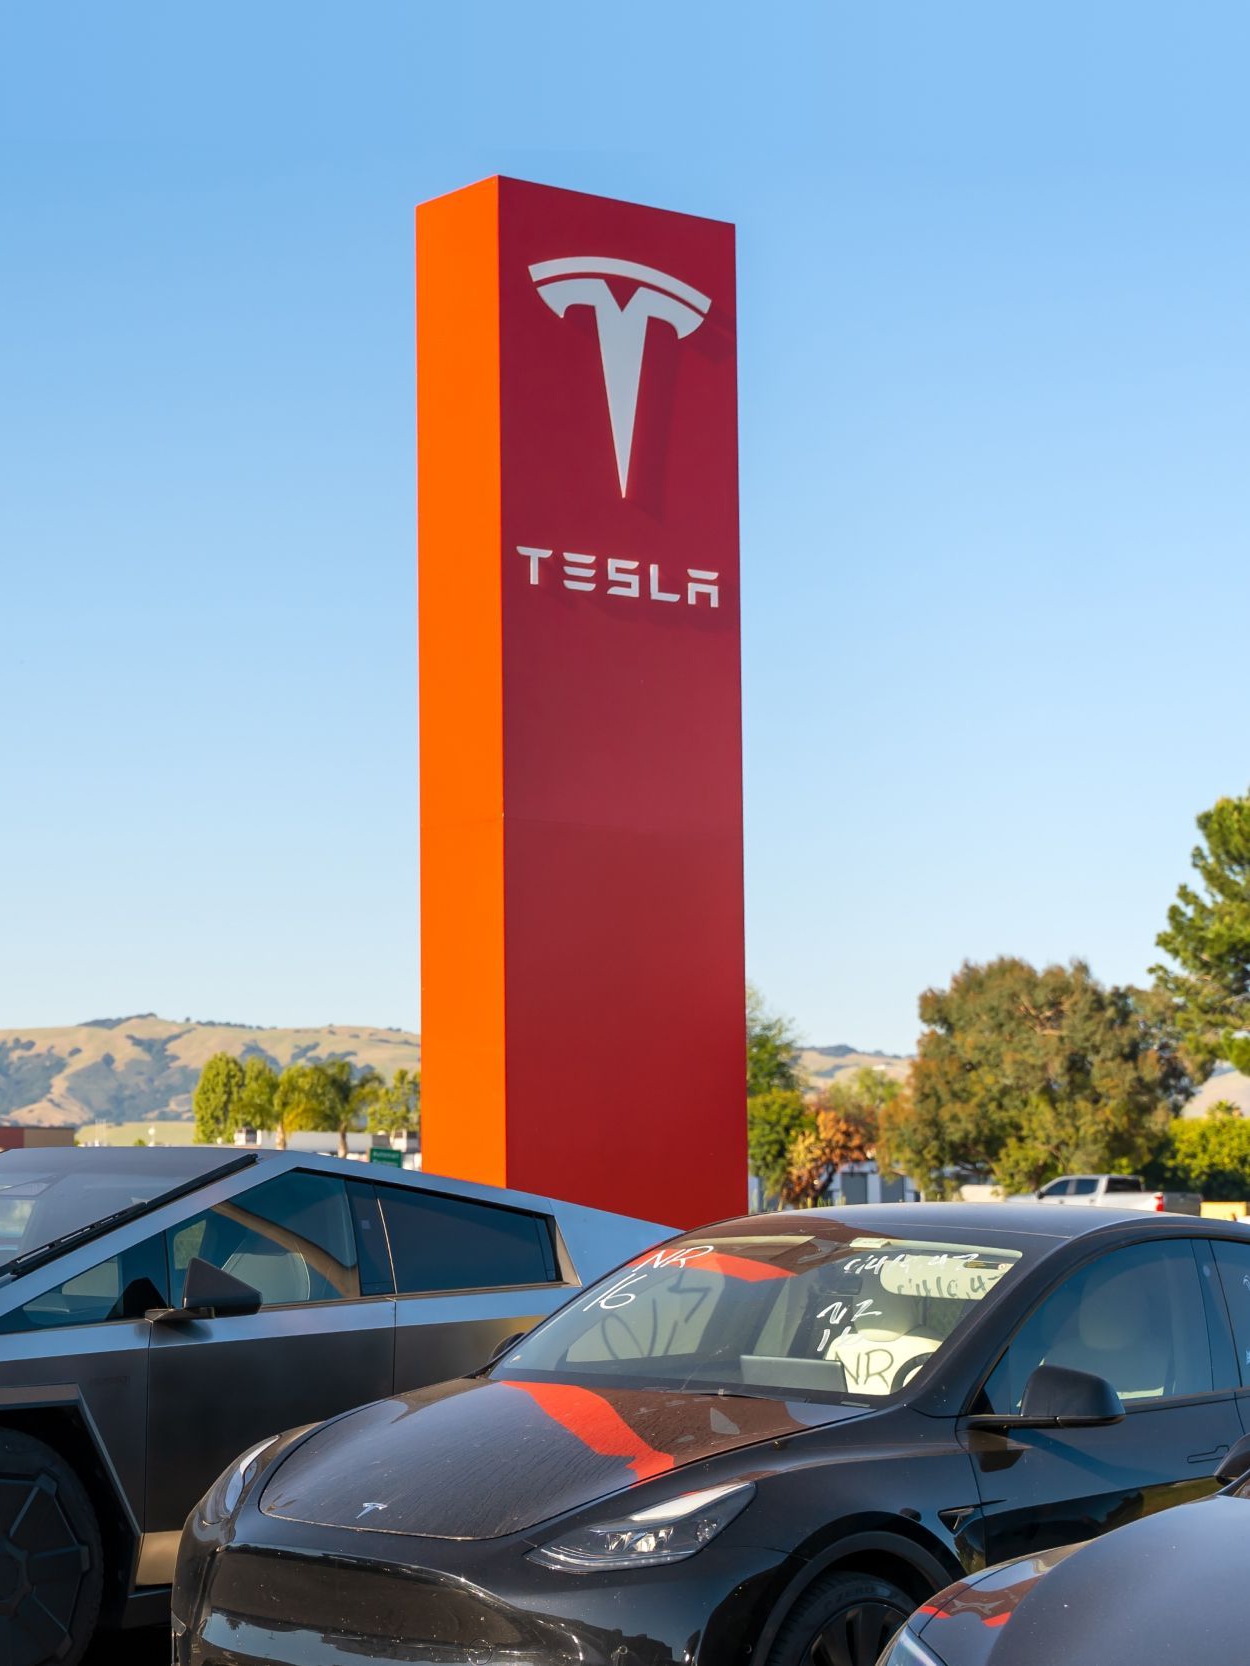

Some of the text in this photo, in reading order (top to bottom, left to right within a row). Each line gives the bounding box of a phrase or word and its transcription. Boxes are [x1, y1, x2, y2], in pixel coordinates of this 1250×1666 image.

[516, 546, 719, 608] TESLA
[632, 1245, 714, 1272] NR
[582, 1273, 648, 1312] 16
